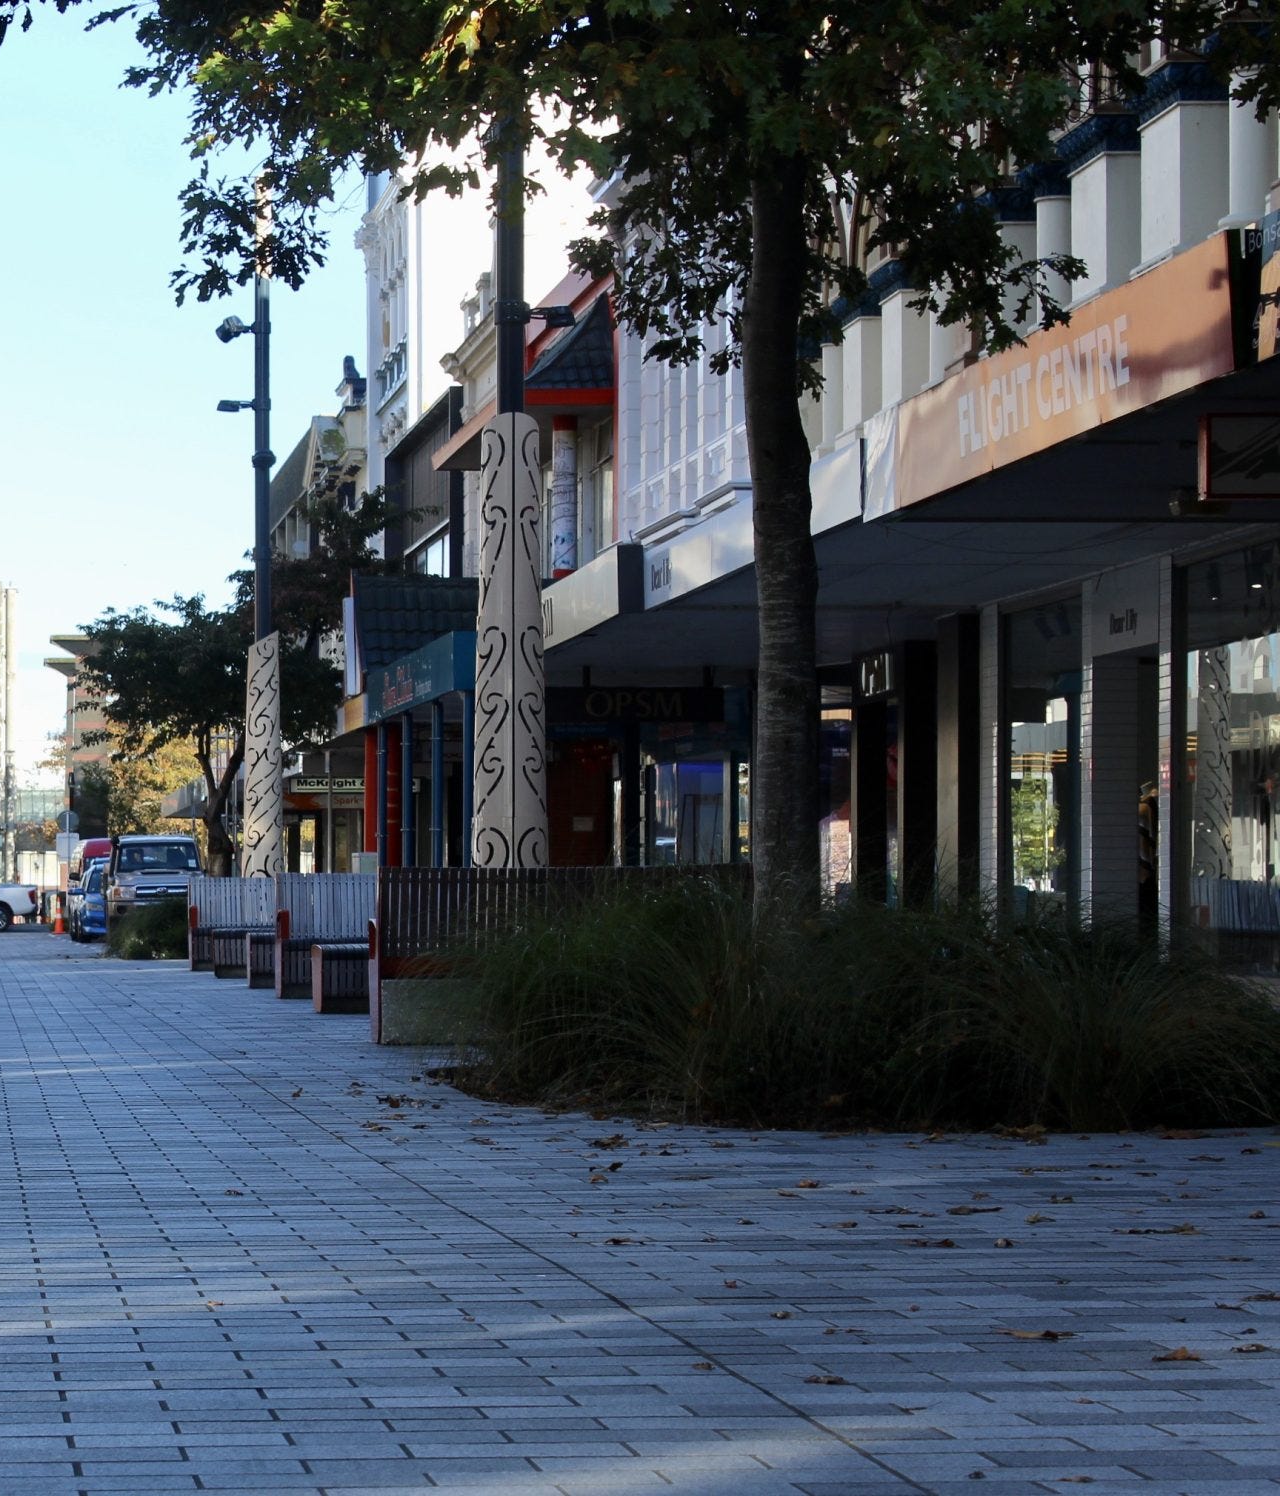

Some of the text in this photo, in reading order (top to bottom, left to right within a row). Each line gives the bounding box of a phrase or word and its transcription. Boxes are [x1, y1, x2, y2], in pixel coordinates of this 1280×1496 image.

[957, 314, 1131, 458] FLIGHT CENTRE
[1109, 607, 1138, 636] Dear Lily
[584, 690, 683, 717] OPSM
[334, 796, 360, 806] Spark
